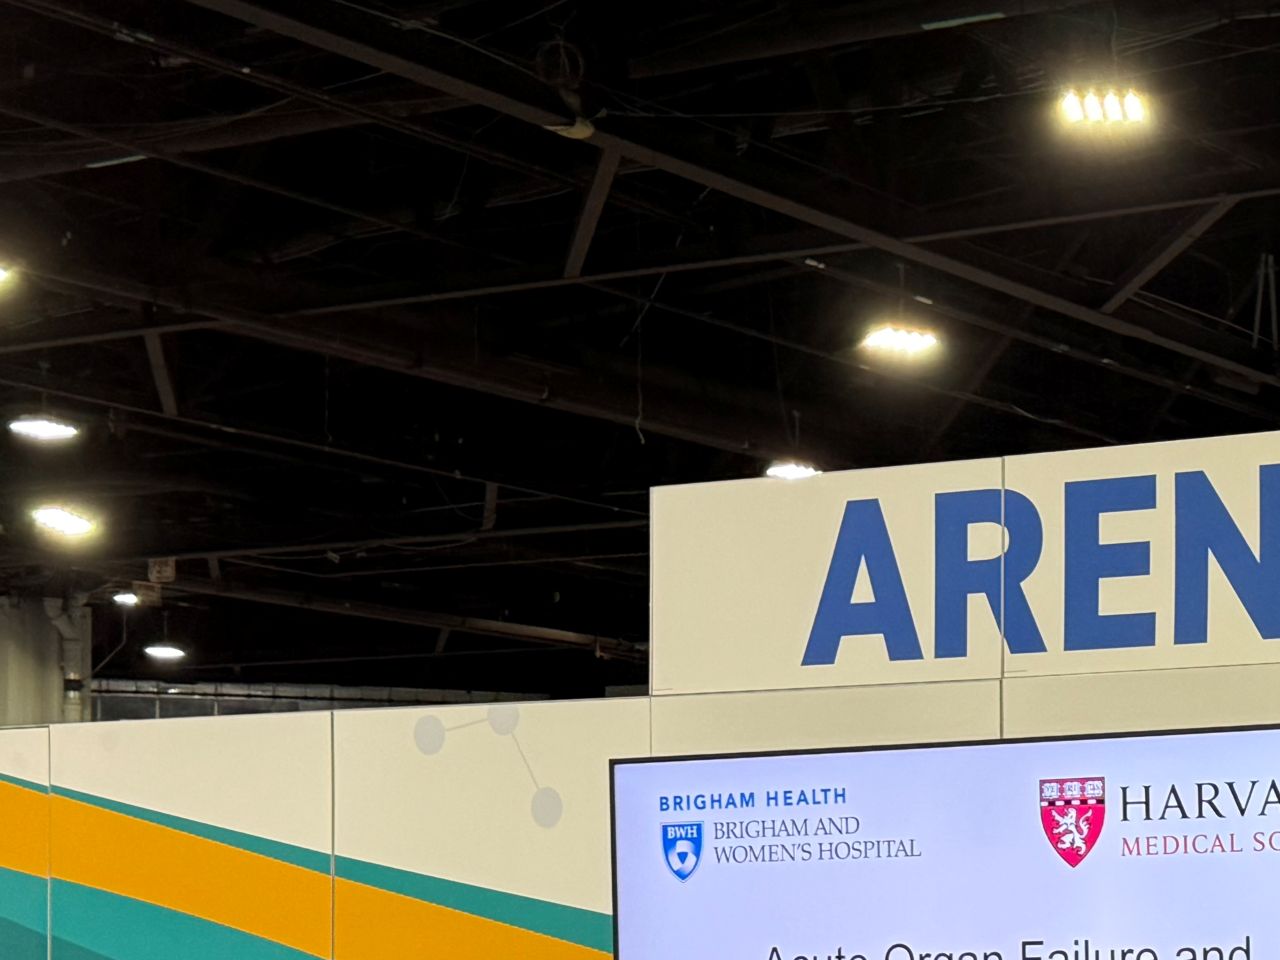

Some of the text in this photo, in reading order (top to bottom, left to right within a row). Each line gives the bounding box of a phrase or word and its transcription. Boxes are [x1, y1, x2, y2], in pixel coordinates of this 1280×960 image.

[659, 788, 847, 812] BRIGHAM HEALTH
[666, 825, 698, 839] BWH
[713, 816, 860, 840] BRIGHAM AND
[714, 838, 922, 864] WOMEN'S HOSPITAL
[1121, 833, 1243, 857] MEDICAL
